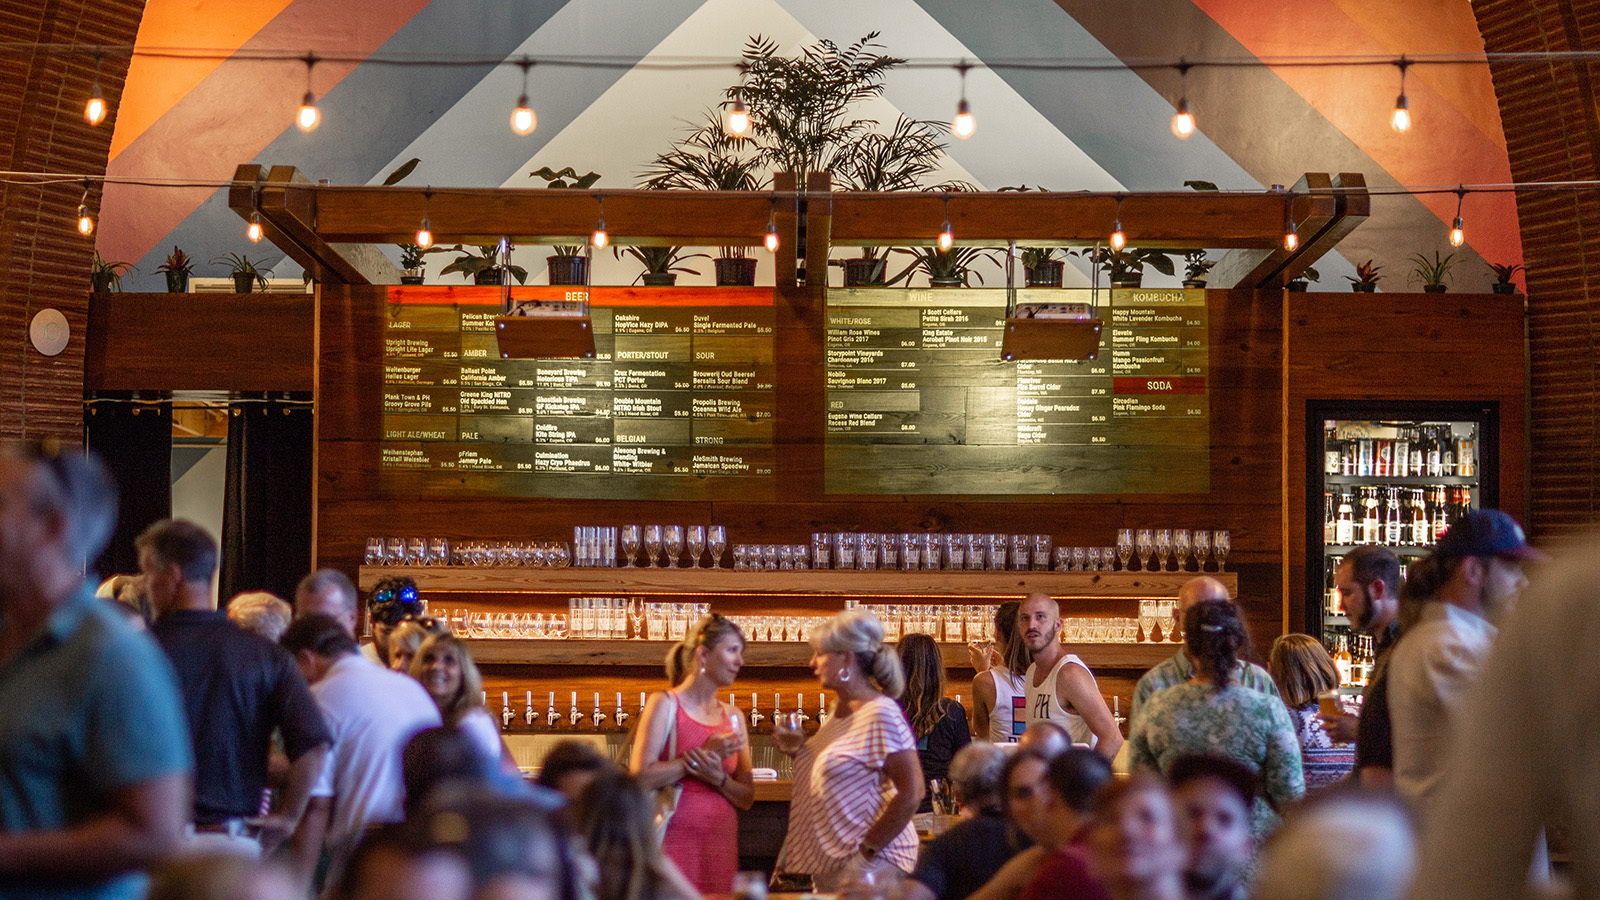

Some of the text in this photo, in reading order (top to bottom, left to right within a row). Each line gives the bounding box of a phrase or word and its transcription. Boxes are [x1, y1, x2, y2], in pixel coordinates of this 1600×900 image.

[565, 292, 589, 301] BEER
[908, 292, 934, 301] WINE
[1133, 293, 1185, 302] KOMBUCHA
[1112, 357, 1131, 365] Mango
[564, 369, 586, 377] Brewing
[1147, 381, 1172, 390] SODA
[471, 398, 495, 406] Speckled
[718, 399, 740, 407] Brewing
[831, 401, 843, 409] RED
[407, 431, 445, 439] ALE/WHEAT
[616, 435, 646, 443] BELGIAN
[695, 436, 723, 444] STRONG
[637, 448, 660, 456] Brewing
[550, 459, 563, 467] Cryo
[721, 463, 749, 471] Speedway
